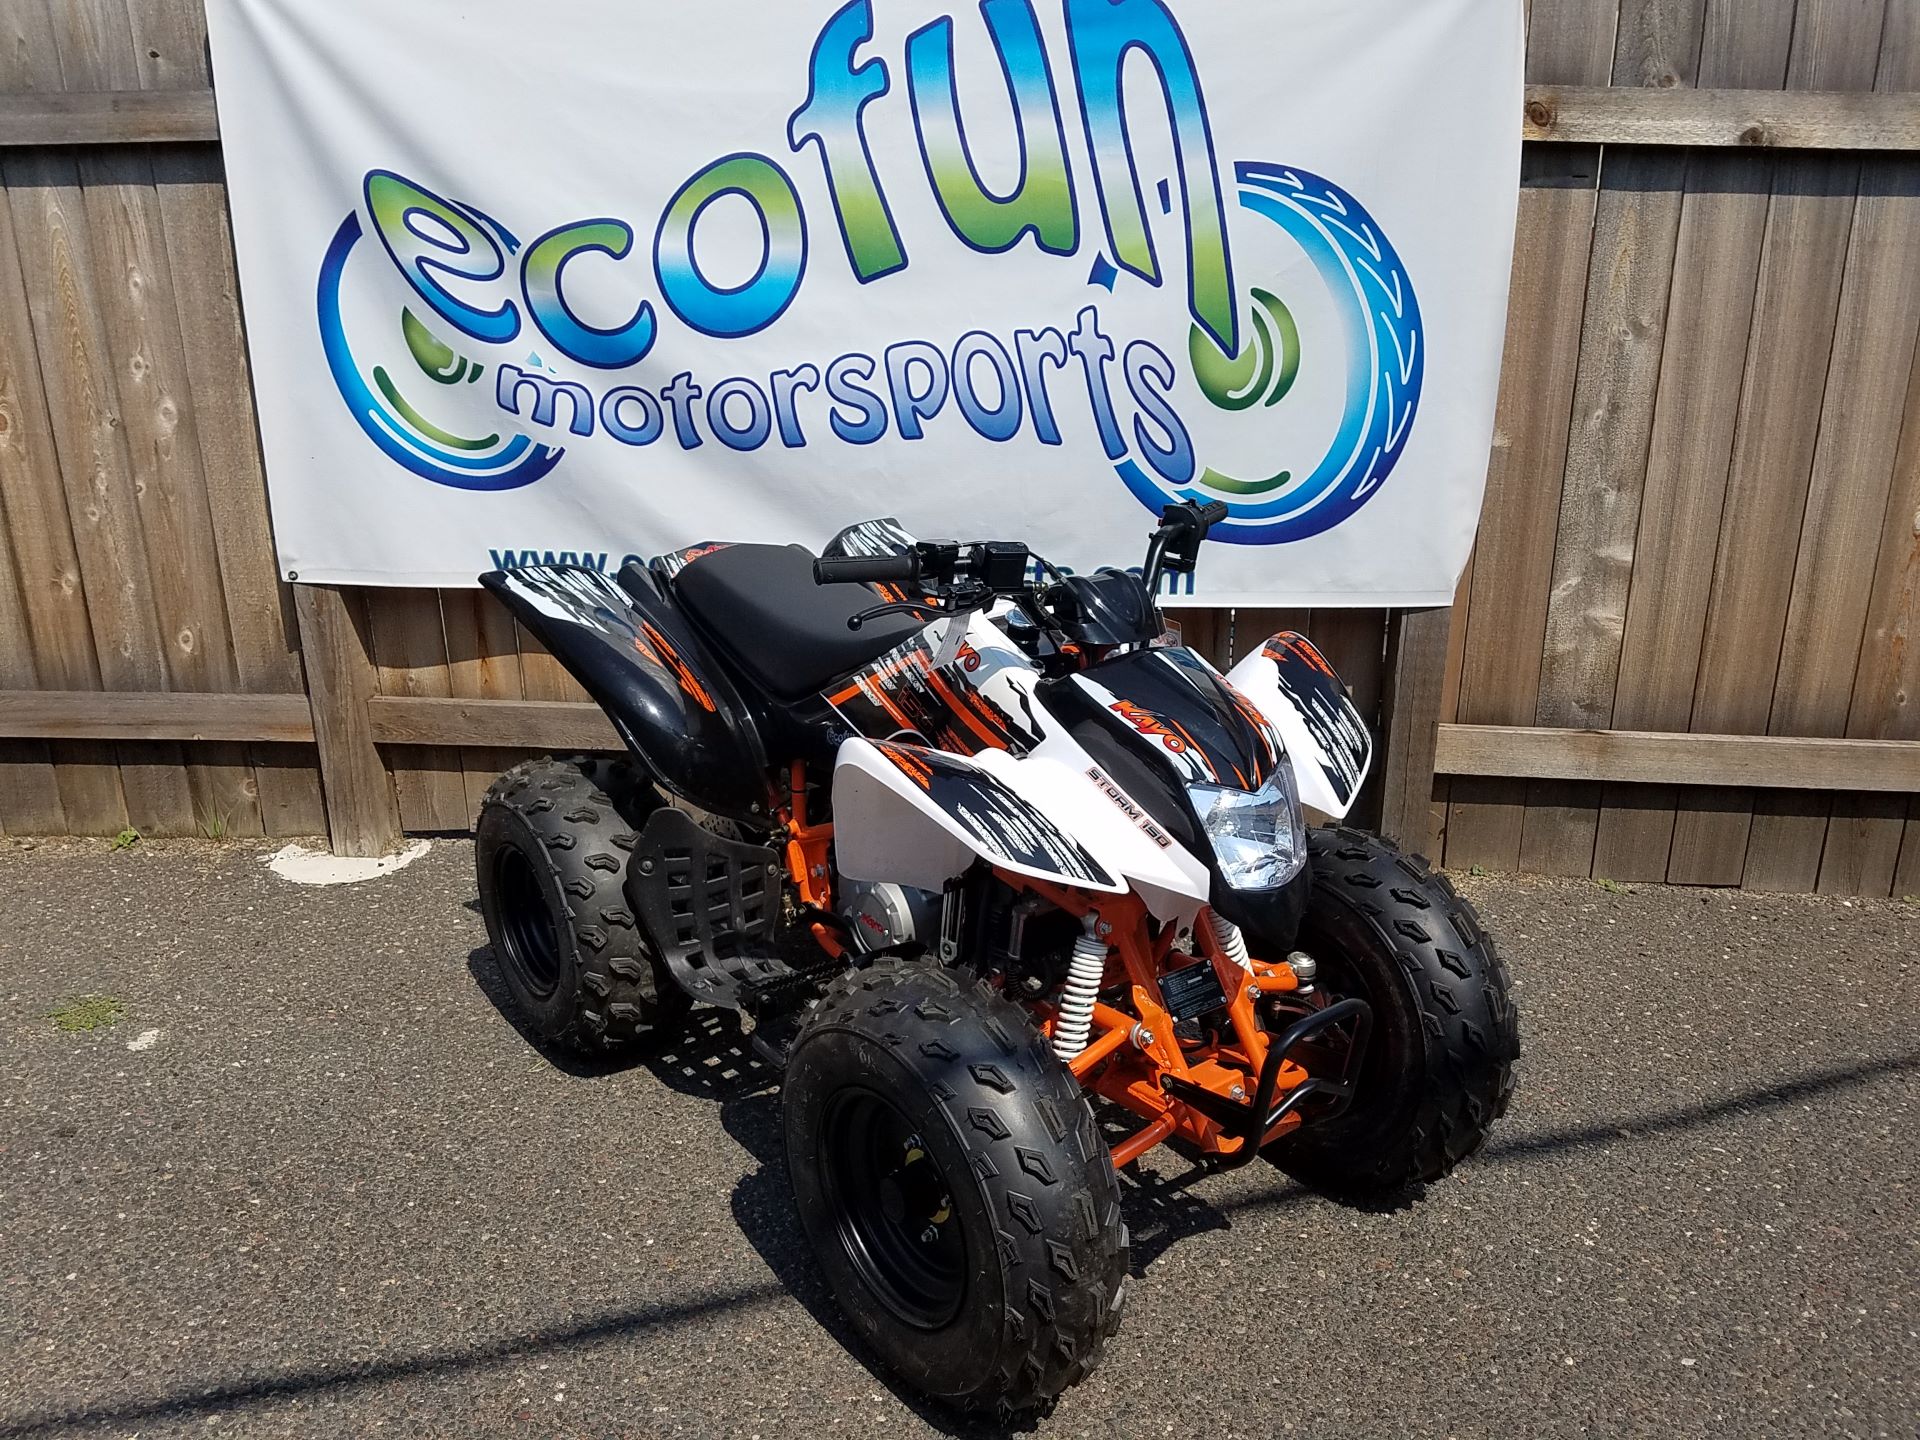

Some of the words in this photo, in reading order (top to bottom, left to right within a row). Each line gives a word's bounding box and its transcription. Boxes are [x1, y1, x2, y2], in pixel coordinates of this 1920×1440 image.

[363, 0, 1239, 370] ecofun
[496, 305, 1197, 485] motorsports
[1108, 699, 1187, 754] KAYO
[1086, 766, 1144, 822] STORM
[1138, 818, 1173, 849] 150
